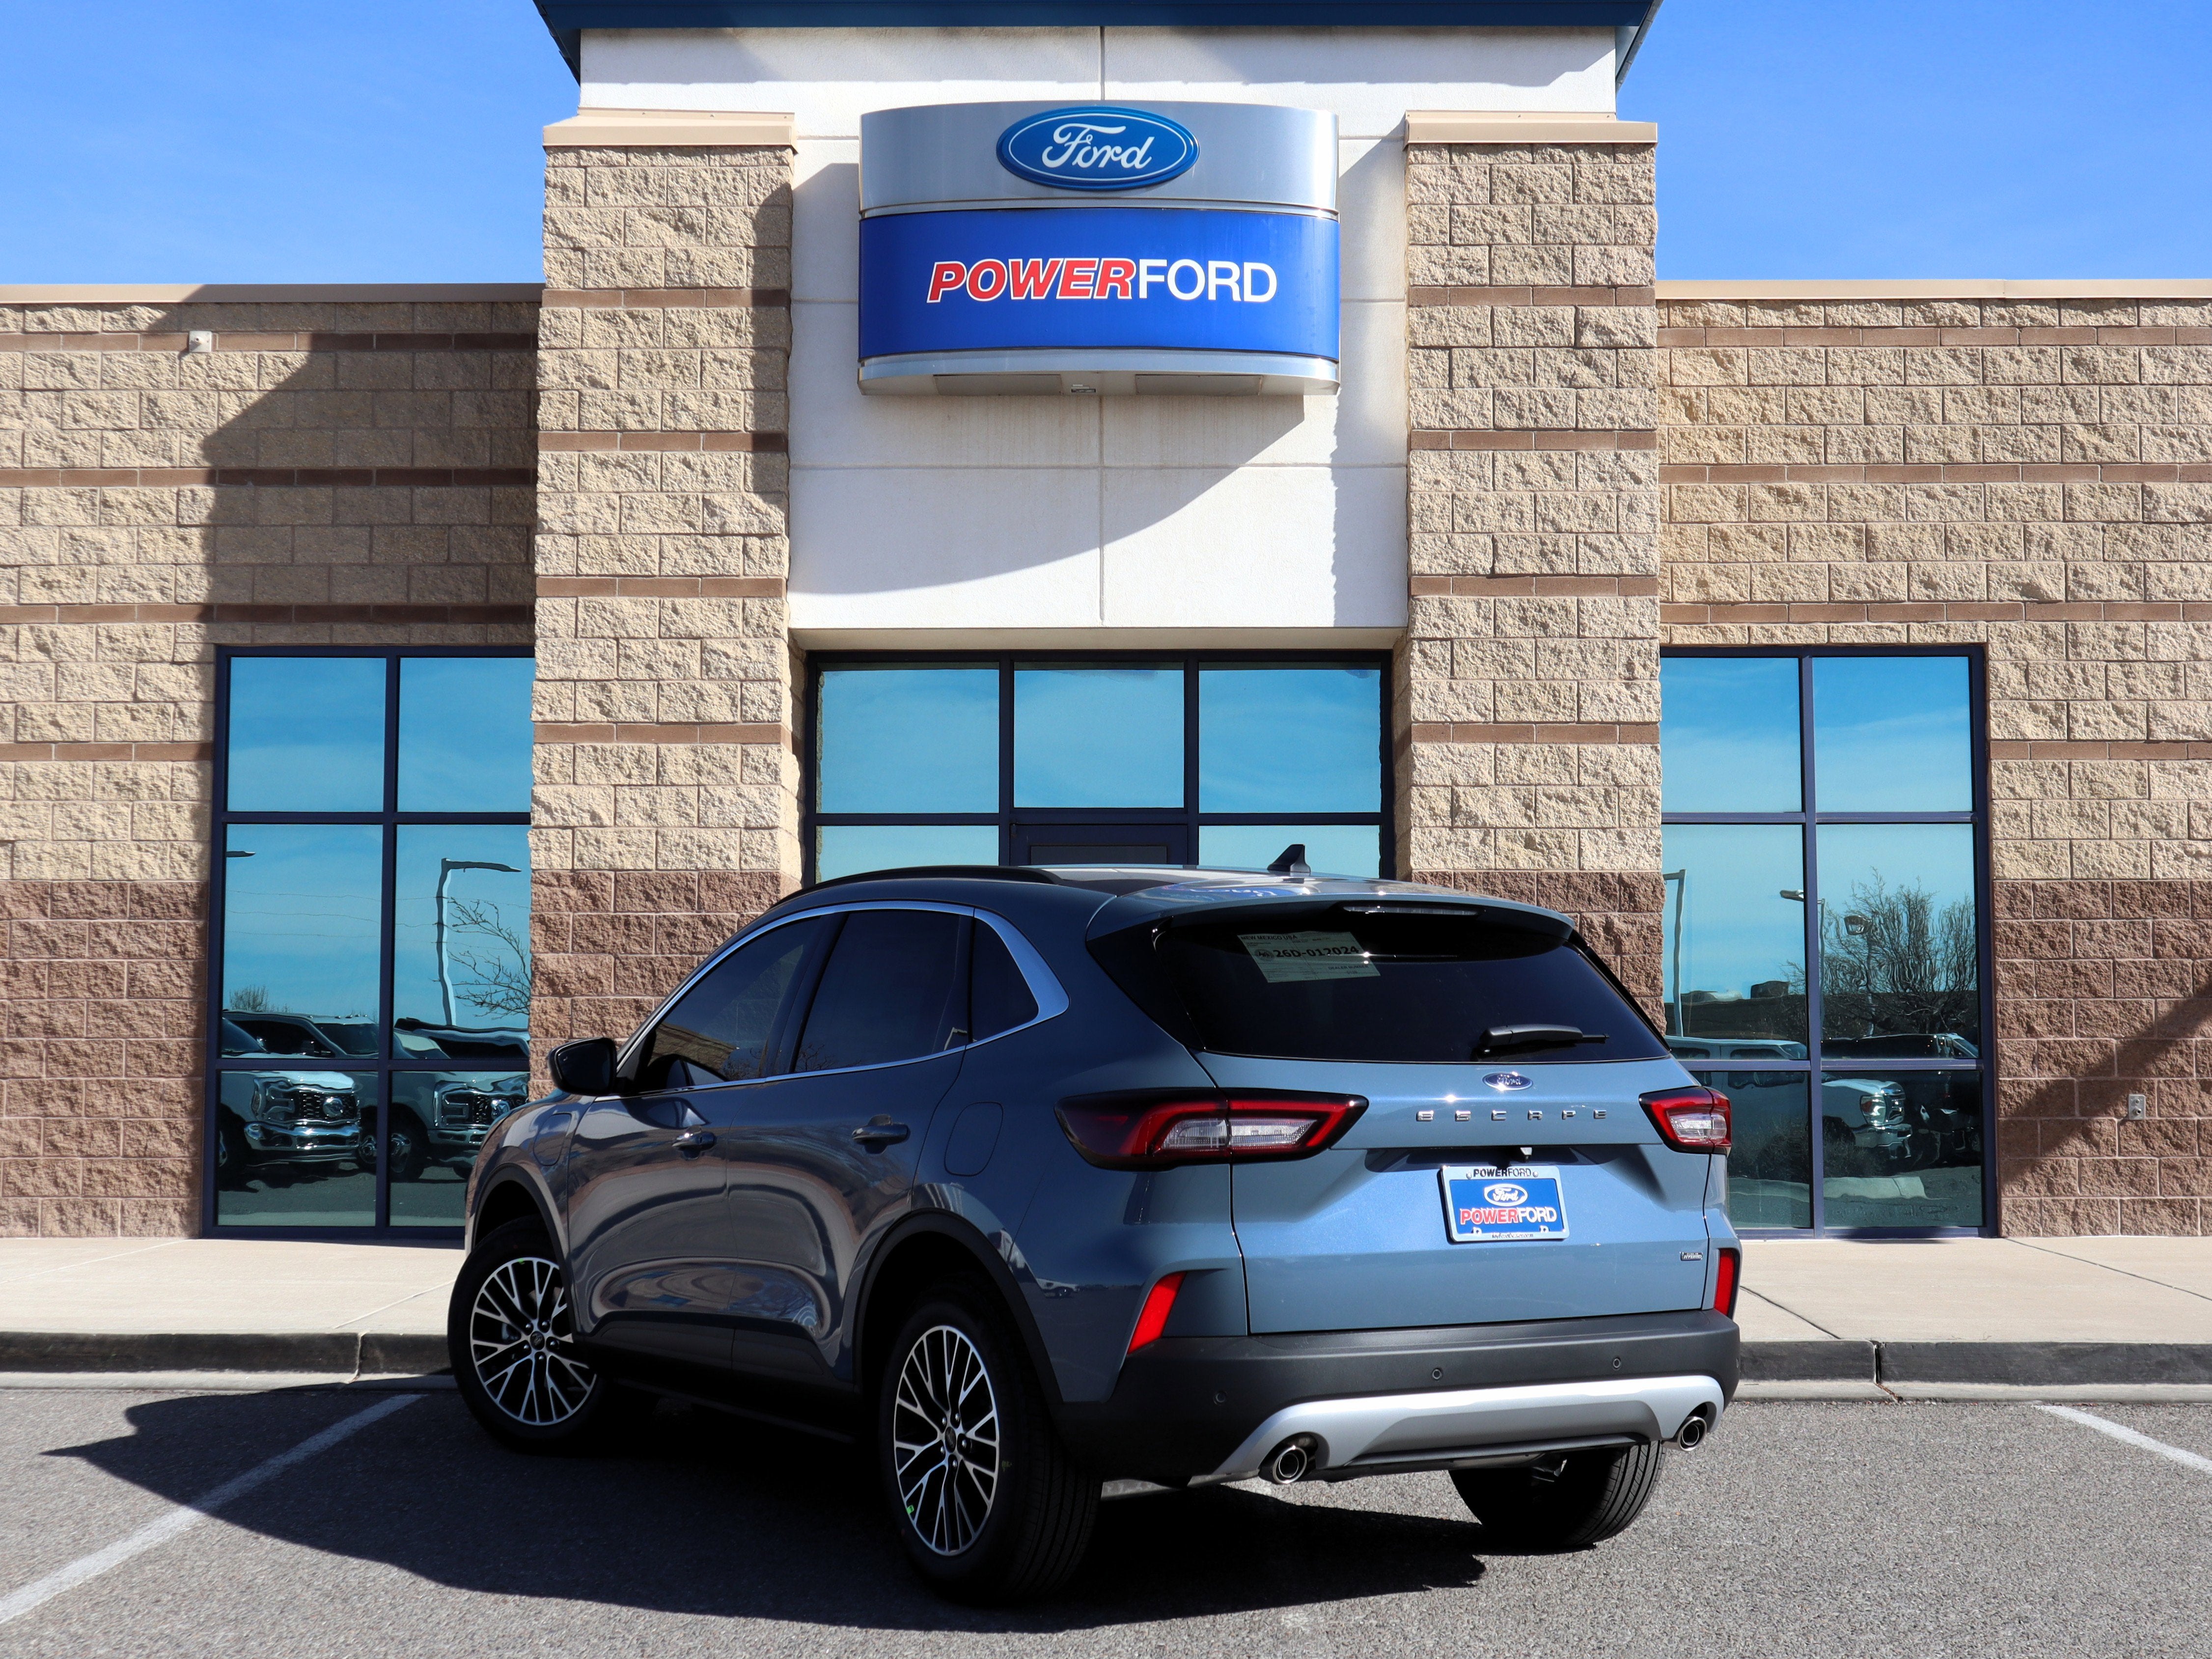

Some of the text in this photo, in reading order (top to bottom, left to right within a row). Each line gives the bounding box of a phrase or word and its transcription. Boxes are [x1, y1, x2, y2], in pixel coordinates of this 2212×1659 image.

[1042, 123, 1154, 169] Ford
[1275, 946, 1359, 958] 26D-012024
[1497, 1074, 1522, 1086] Ford
[1416, 1109, 1607, 1121] ESCAPE
[1473, 1168, 1531, 1177] POWERFORD
[1493, 1188, 1519, 1201] Ford
[1460, 1207, 1557, 1225] POWERFORD
